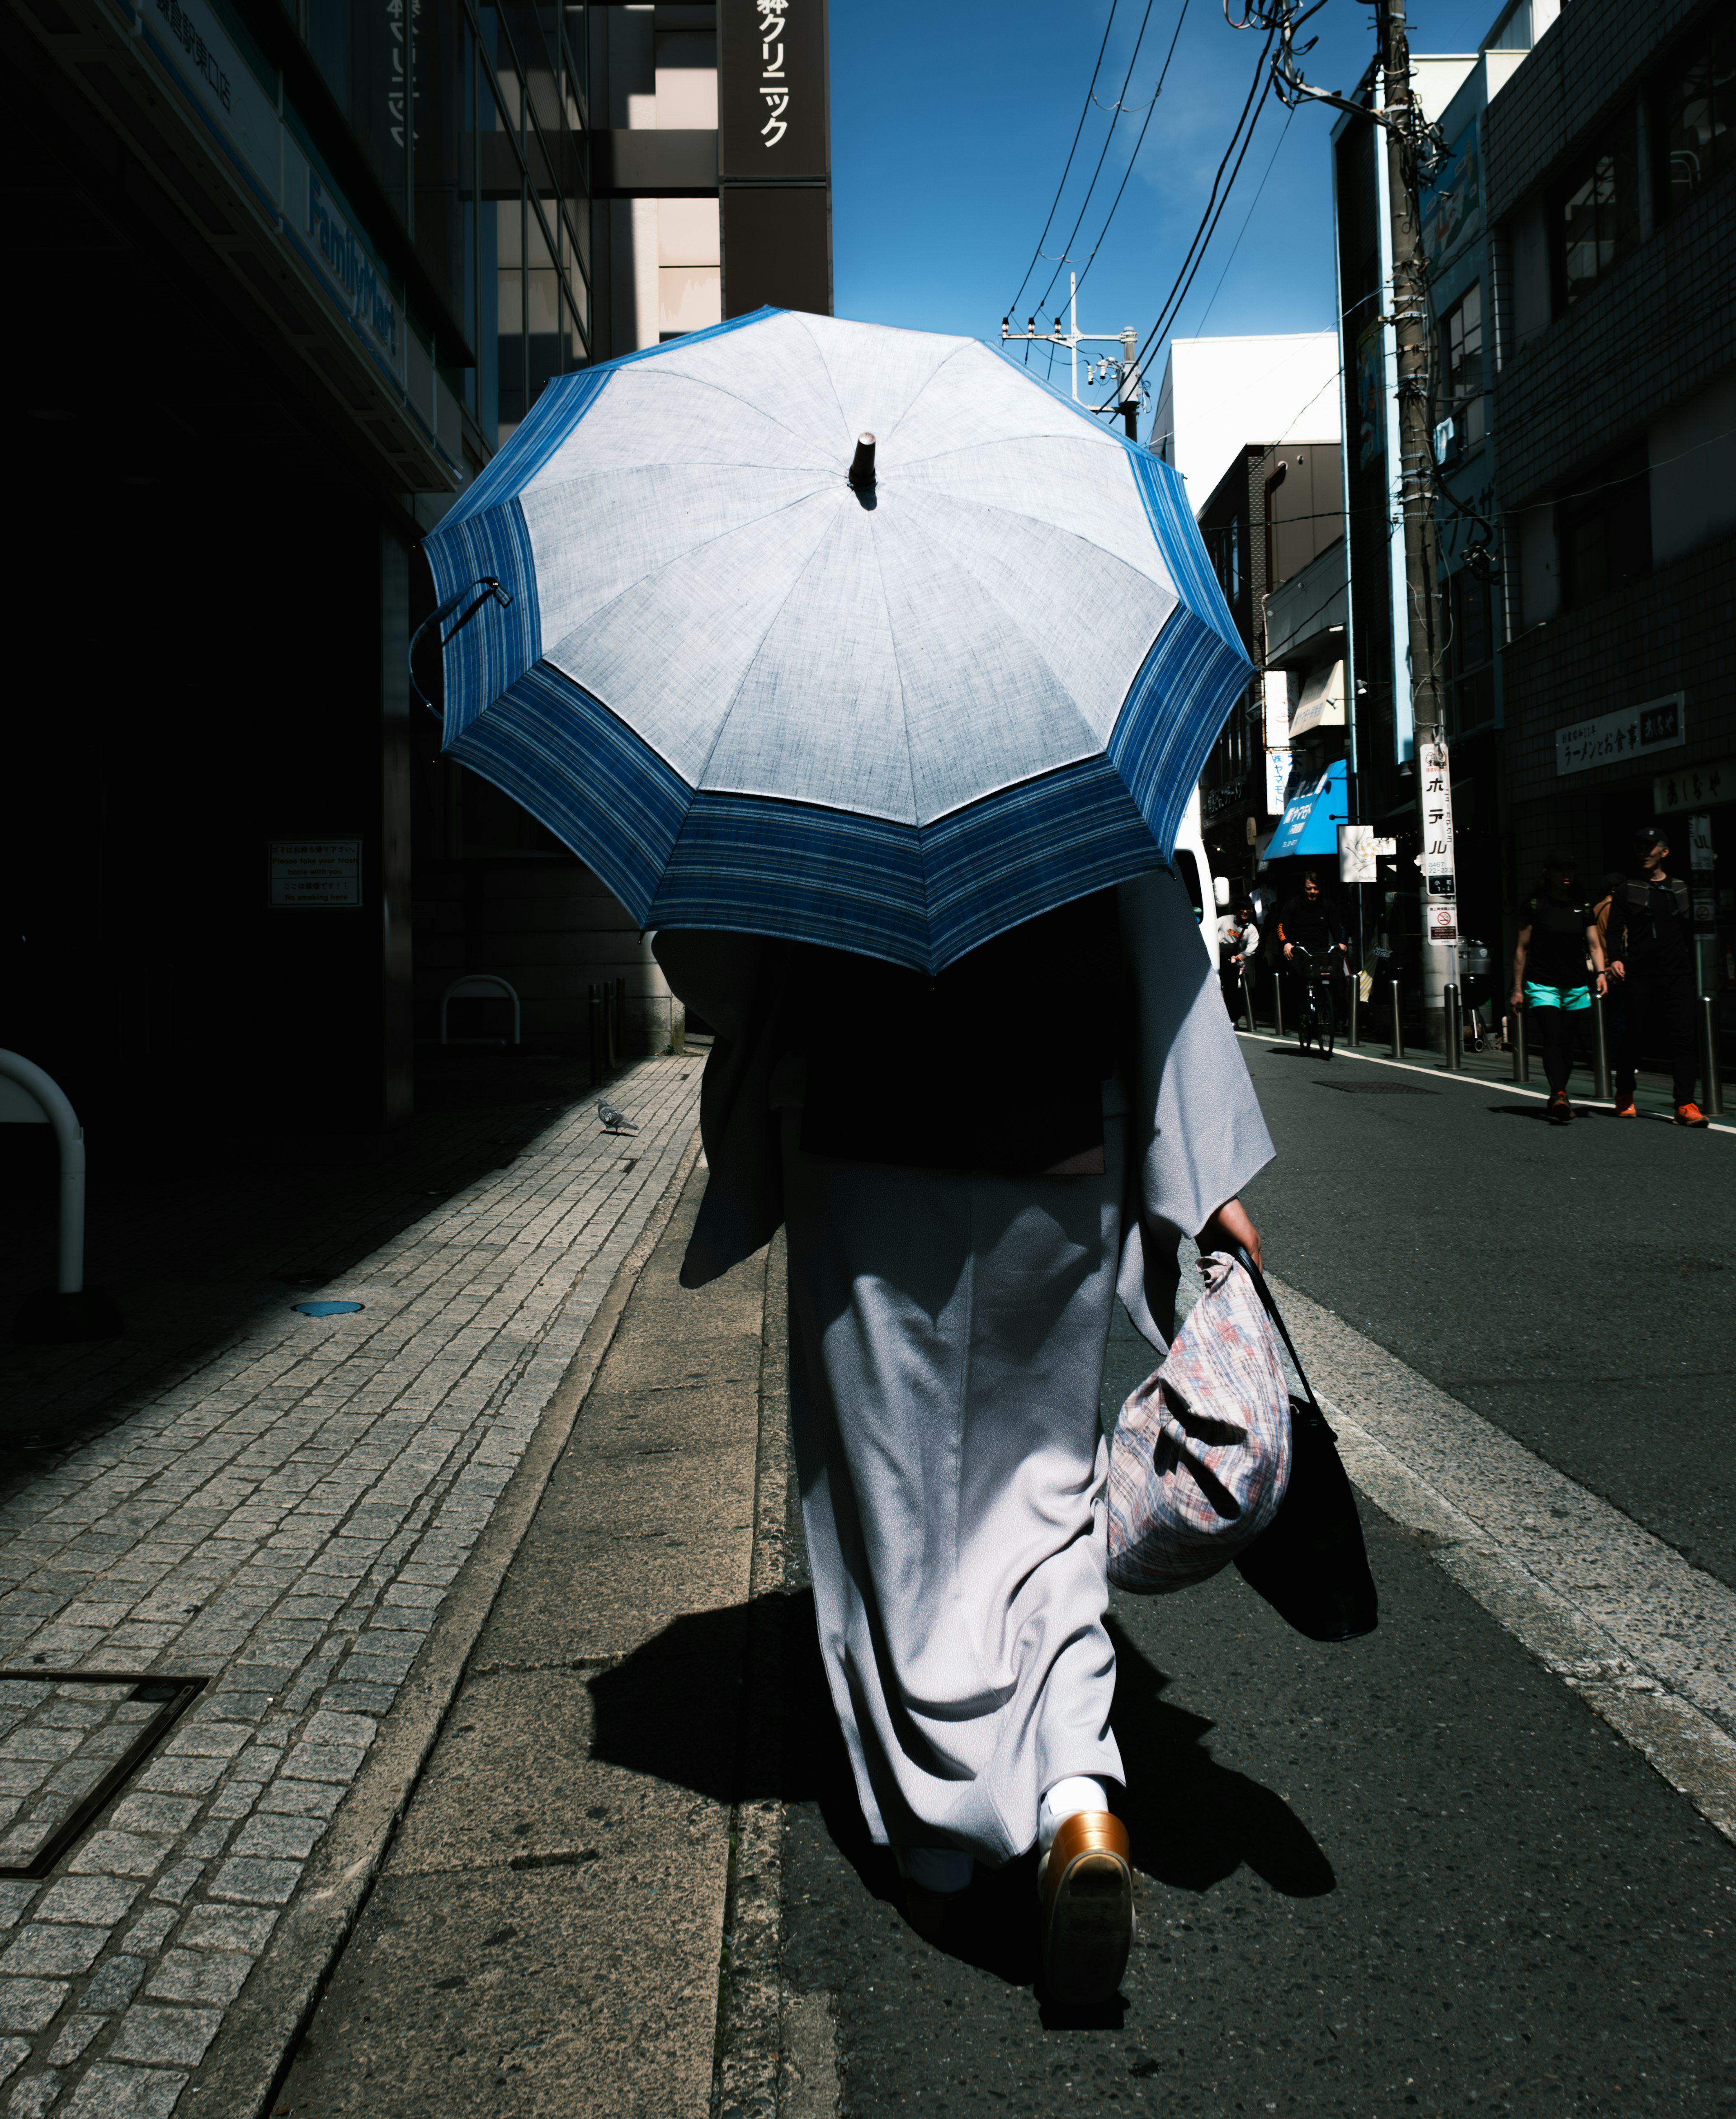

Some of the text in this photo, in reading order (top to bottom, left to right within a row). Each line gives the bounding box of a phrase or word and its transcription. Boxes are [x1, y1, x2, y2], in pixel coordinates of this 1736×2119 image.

[308, 167, 396, 356] FamilyMart
[1565, 724, 1637, 766] ラーメンとお食事
[1426, 778, 1447, 855] ホテル
[1667, 769, 1721, 807] あしなや
